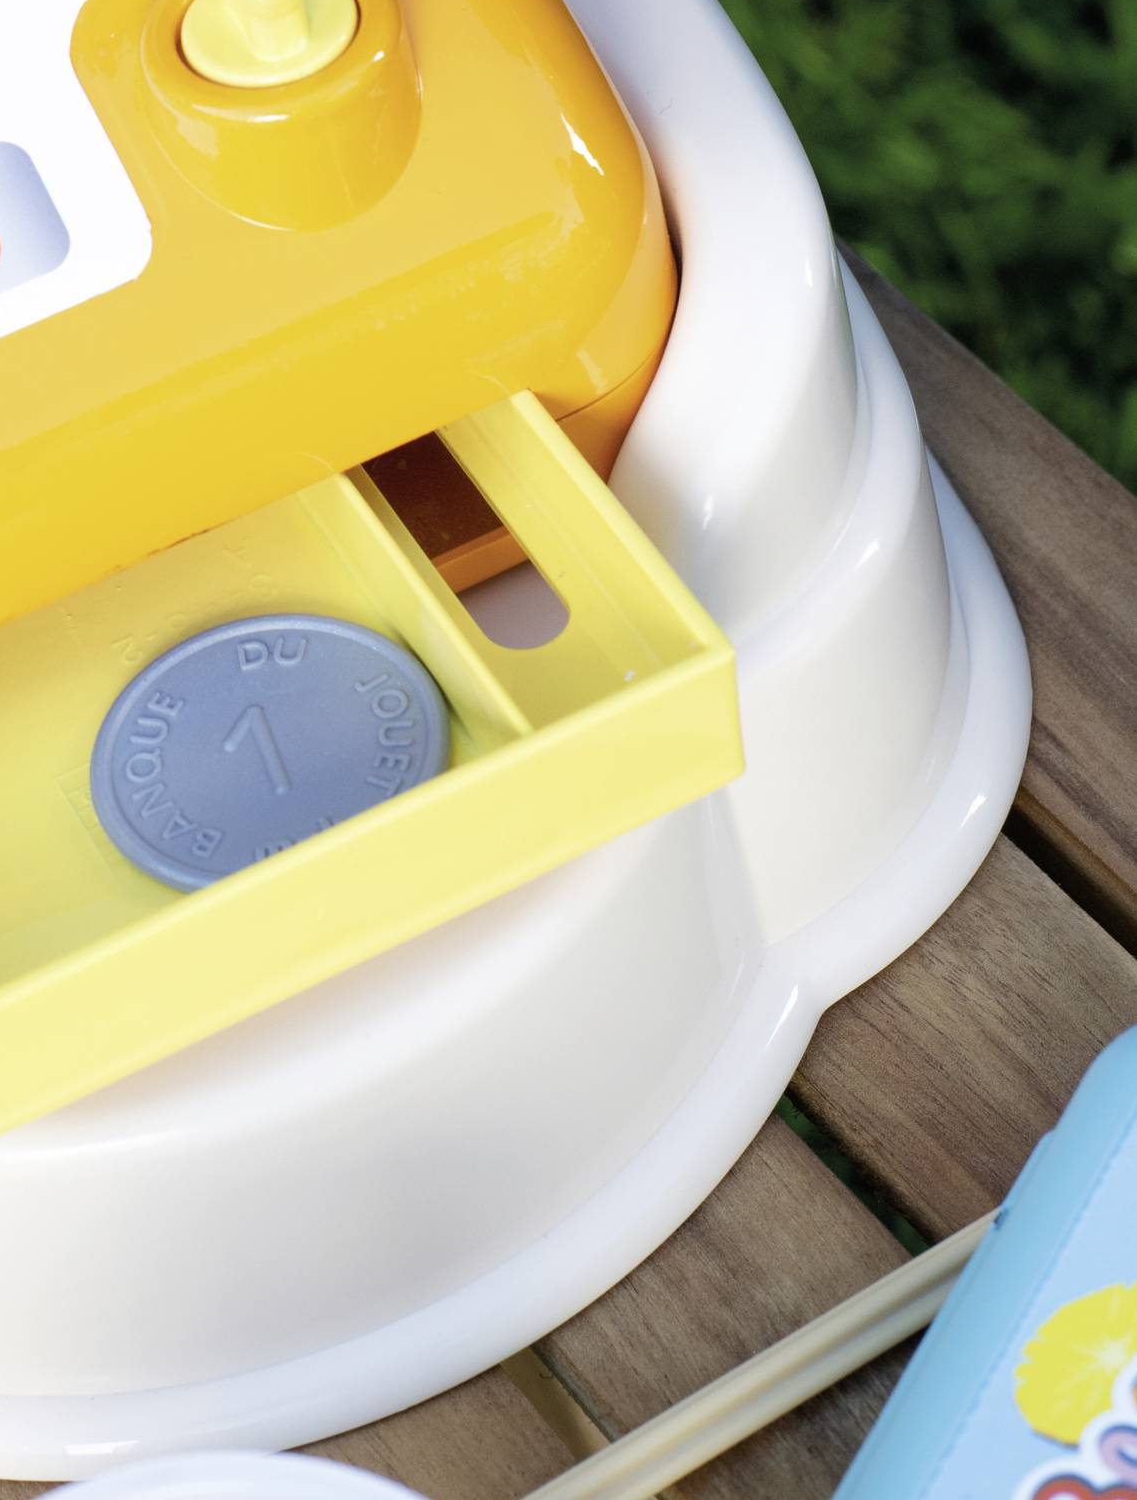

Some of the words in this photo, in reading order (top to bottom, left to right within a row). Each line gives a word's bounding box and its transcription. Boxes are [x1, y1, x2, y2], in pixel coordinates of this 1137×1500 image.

[124, 690, 224, 859] BANQUE
[236, 636, 308, 672] DU
[353, 672, 416, 799] JOUET
[221, 704, 292, 797] 1
